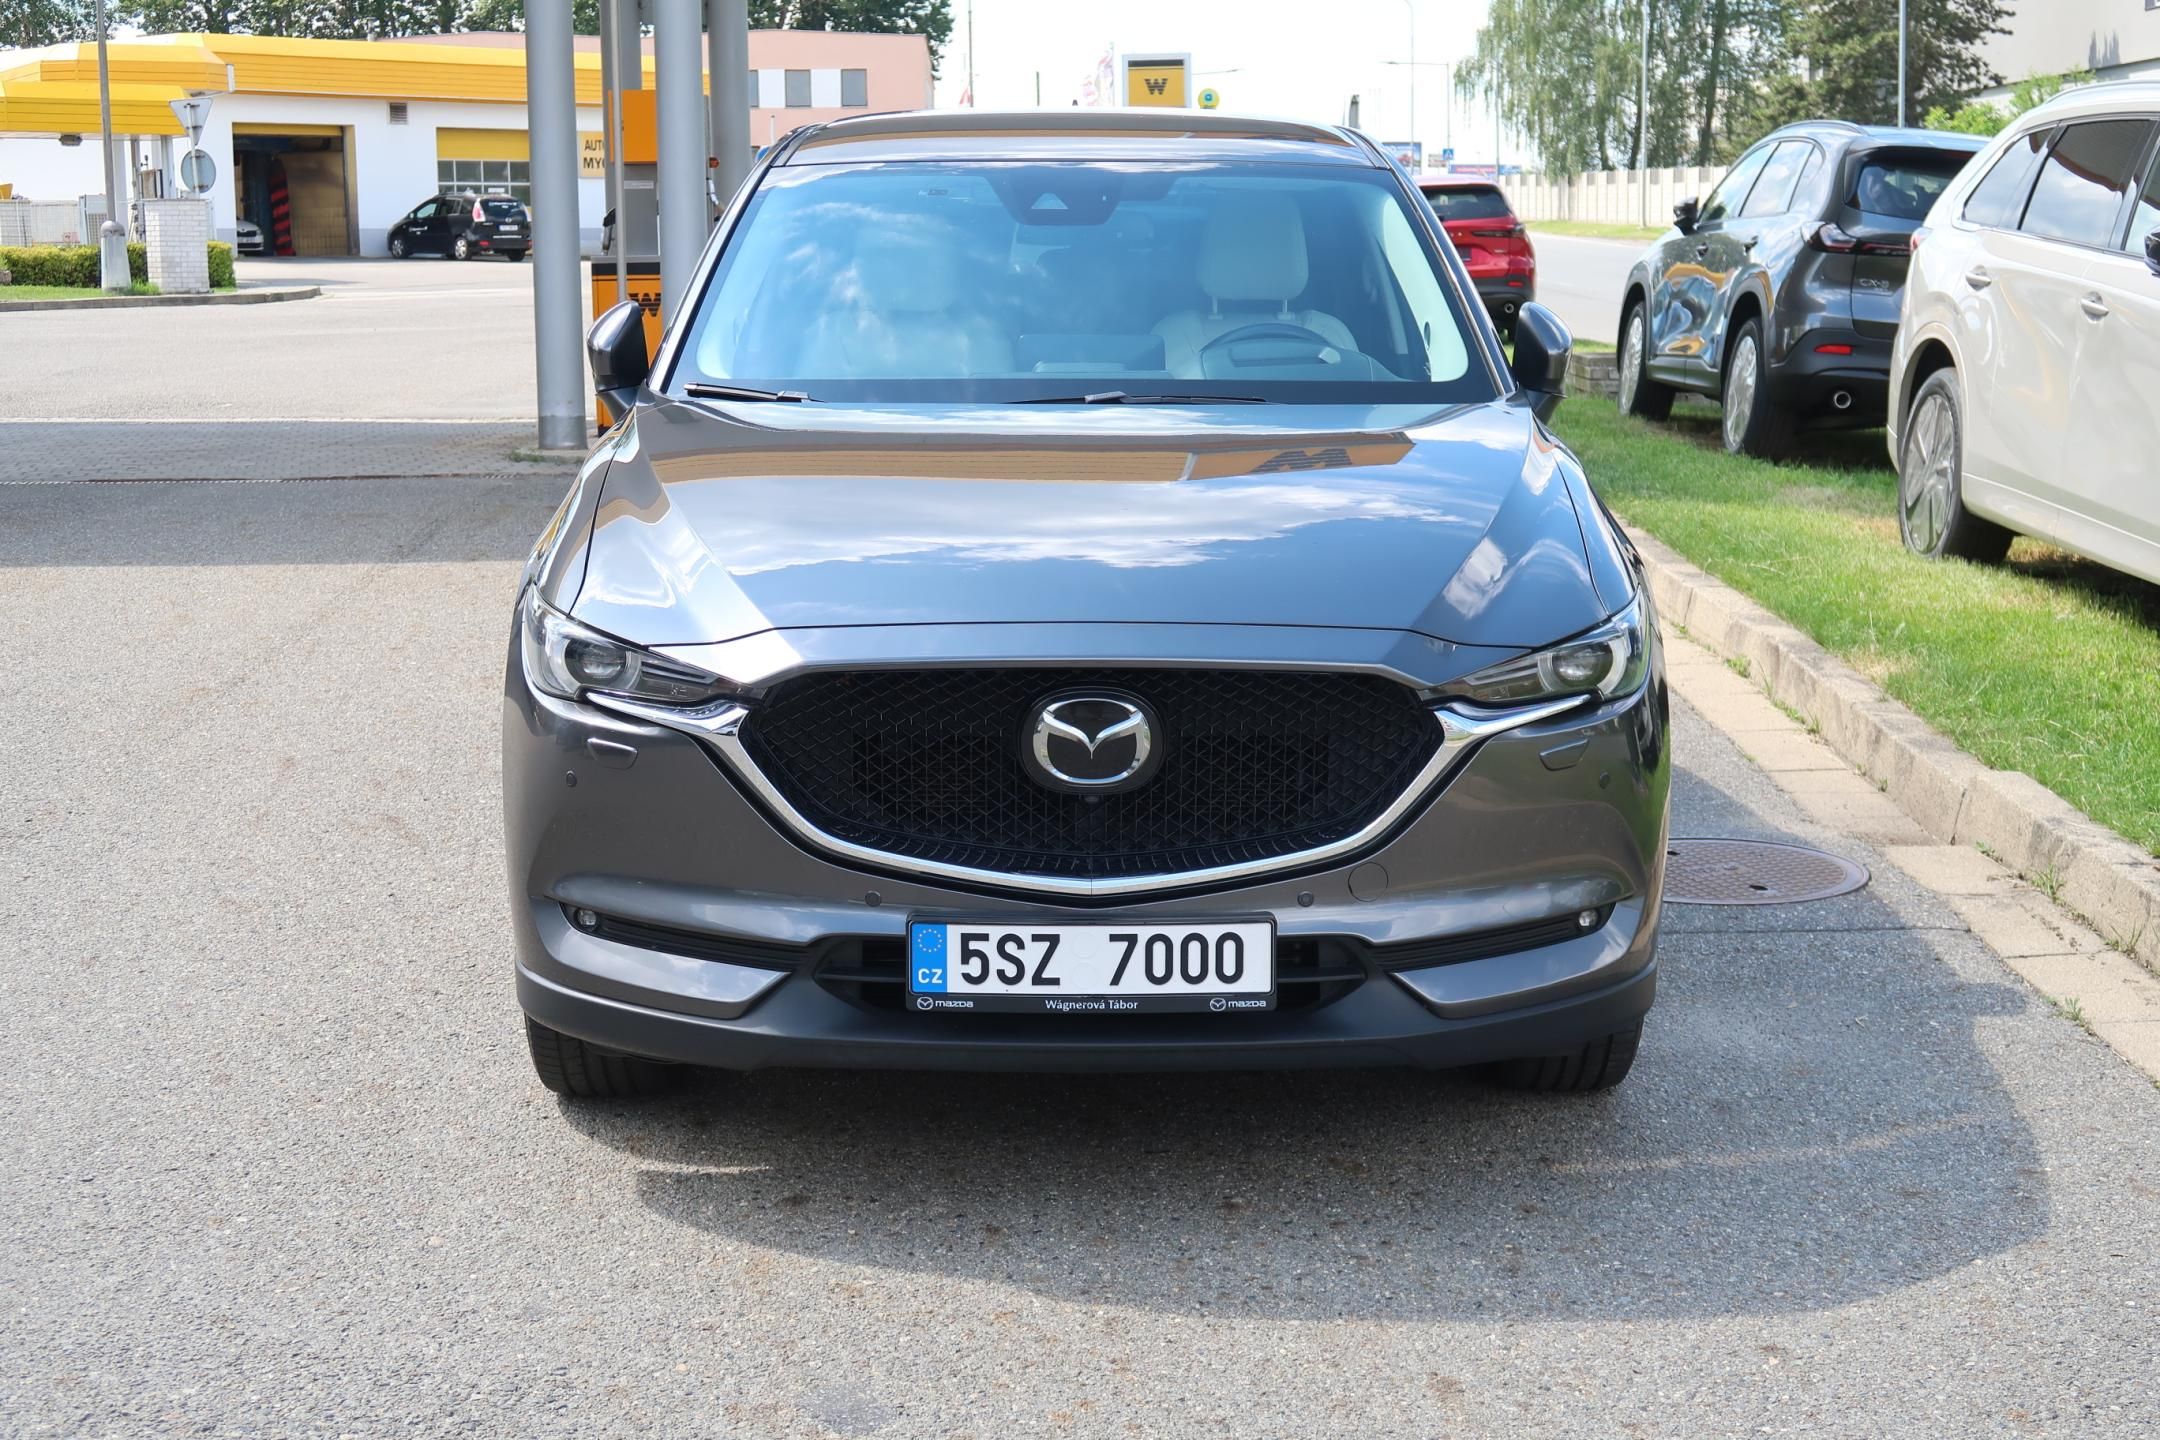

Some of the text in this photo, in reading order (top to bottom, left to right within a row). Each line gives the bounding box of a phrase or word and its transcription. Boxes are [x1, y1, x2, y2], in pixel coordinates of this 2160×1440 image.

[1144, 78, 1168, 95] W
[960, 931, 1245, 986] 5SZ 7000
[917, 968, 943, 984] CZ
[935, 1000, 974, 1008] mazda
[1045, 998, 1139, 1011] Wágnerová Tábor
[1228, 1000, 1267, 1008] mazda
